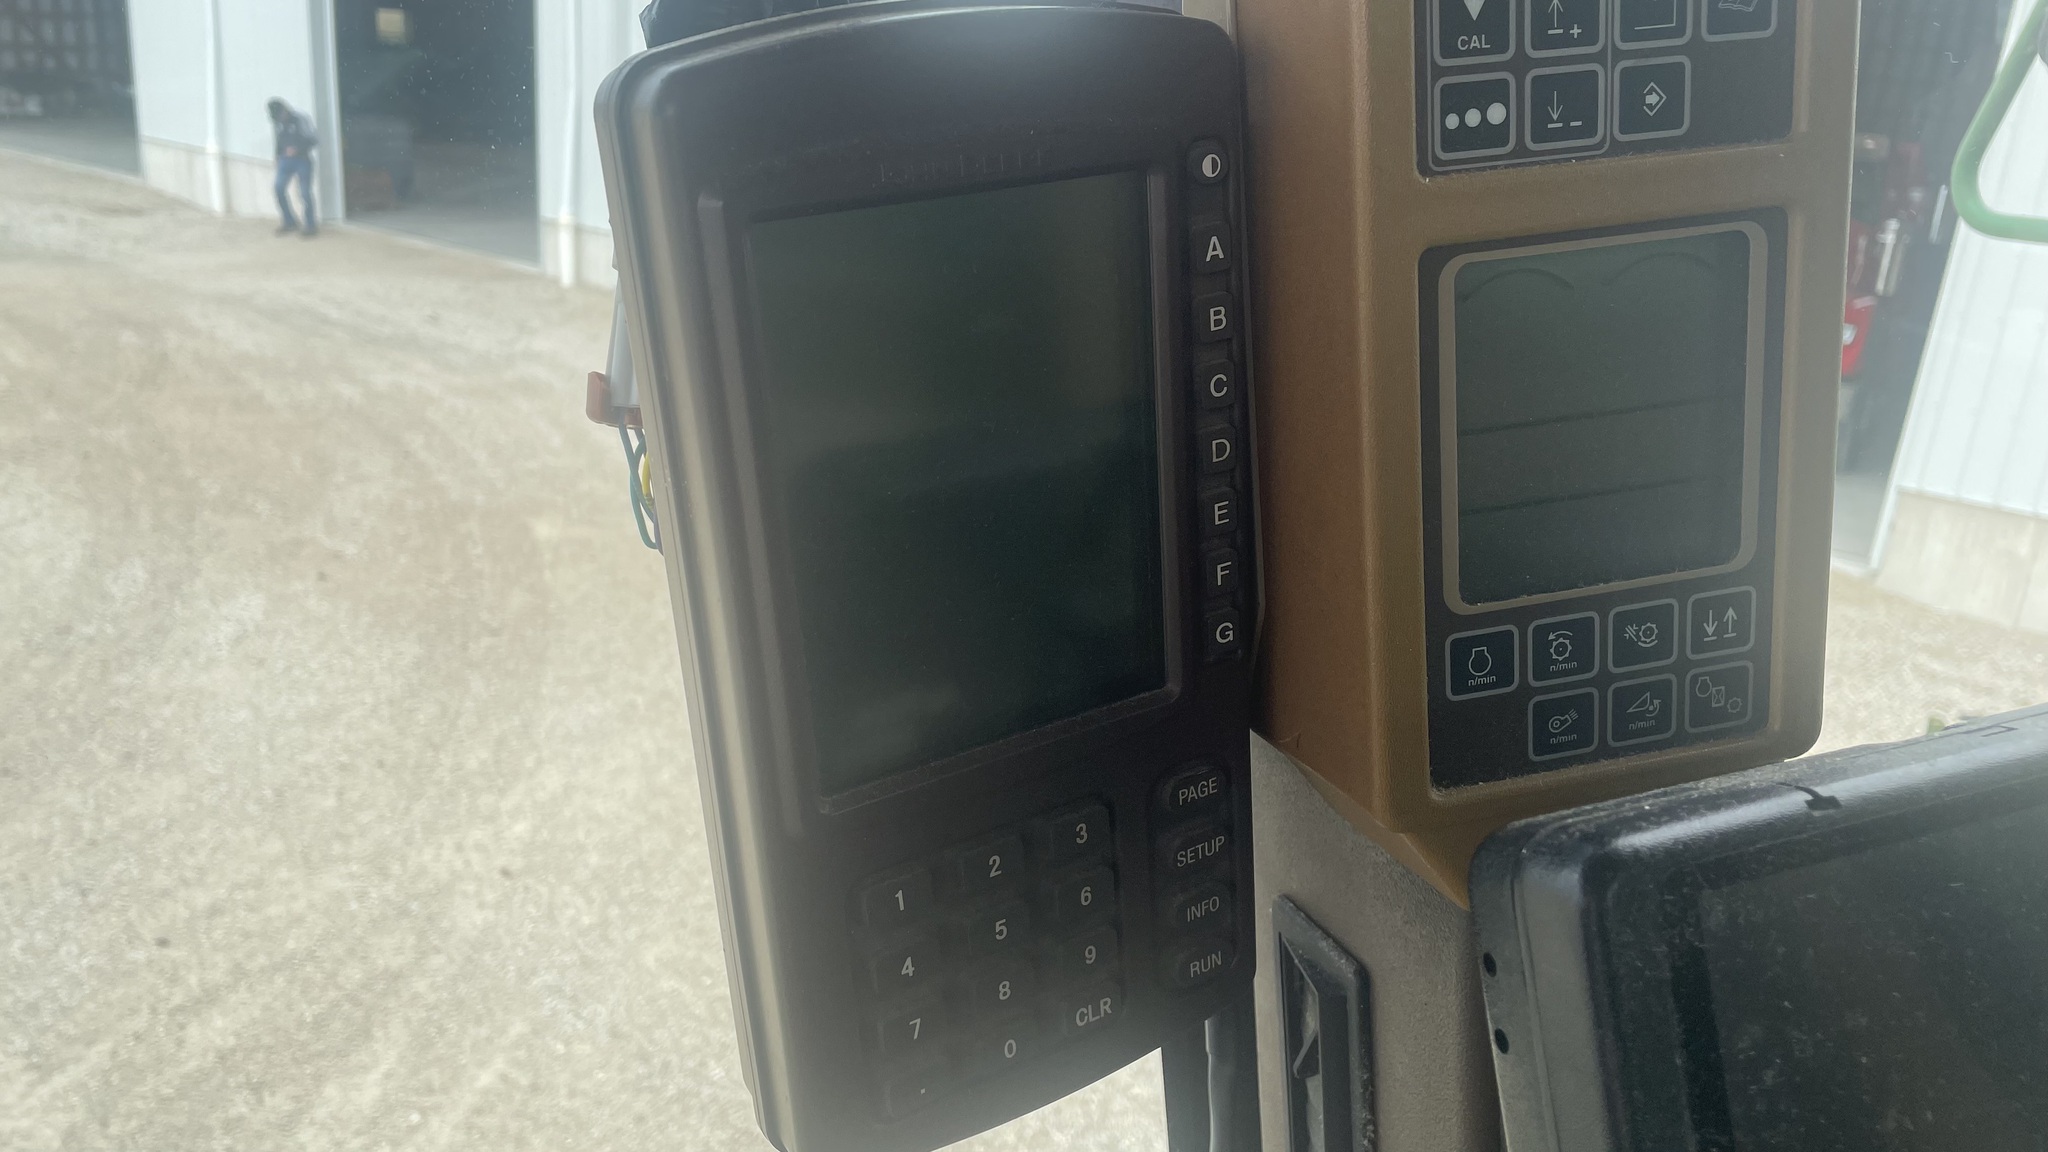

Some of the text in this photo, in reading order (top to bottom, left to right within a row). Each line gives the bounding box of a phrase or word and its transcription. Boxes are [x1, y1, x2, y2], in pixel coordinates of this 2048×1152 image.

[1457, 33, 1491, 51] CAL
[1205, 236, 1225, 262] A
[1209, 306, 1227, 332] B
[1210, 374, 1228, 398] C
[1211, 438, 1231, 463] D
[1213, 501, 1230, 525] E
[1216, 561, 1232, 586] F
[1215, 622, 1234, 644] G
[1549, 660, 1578, 673] n/min
[1467, 674, 1497, 687] n/min
[1628, 717, 1656, 730] n/min
[1549, 732, 1578, 744] n/min
[1177, 777, 1219, 806] PAGE
[1075, 823, 1088, 844] 3
[1176, 835, 1226, 868] SETUP
[988, 855, 1002, 878] 2
[894, 889, 906, 911] 1
[1080, 886, 1093, 906] 6
[1186, 896, 1220, 923] INFO
[995, 919, 1008, 940] 5
[1084, 946, 1097, 964] 9
[1189, 951, 1223, 978] RUN
[901, 956, 915, 977] 4
[998, 981, 1012, 1000] 8
[1075, 997, 1113, 1026] CLR
[909, 1018, 922, 1040] 7
[1004, 1039, 1018, 1059] 0
